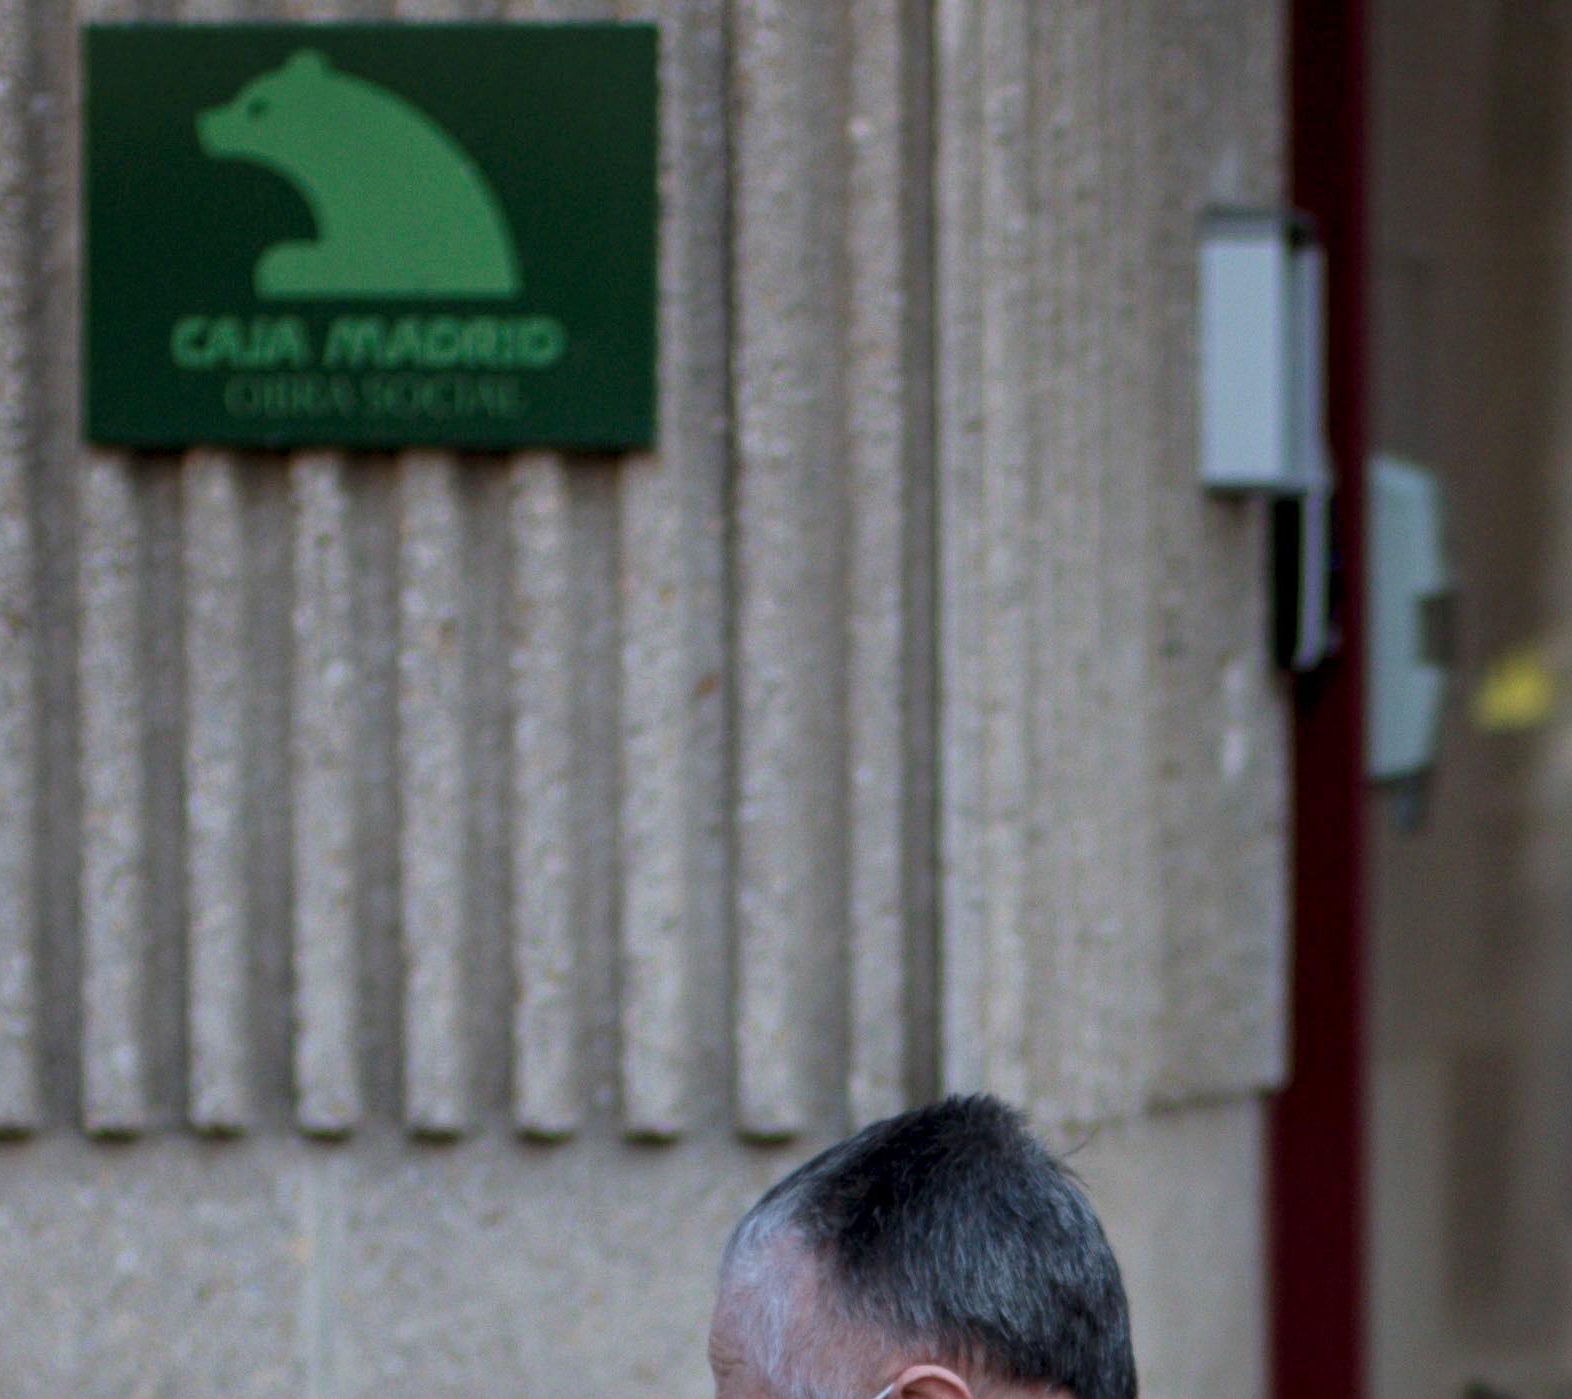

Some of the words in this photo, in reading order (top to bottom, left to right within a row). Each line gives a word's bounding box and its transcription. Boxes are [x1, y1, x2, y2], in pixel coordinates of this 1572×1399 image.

[171, 314, 308, 367] CAJA
[325, 314, 566, 367] MADRID
[225, 374, 359, 418] OBRA
[363, 374, 526, 418] SOCIAL
